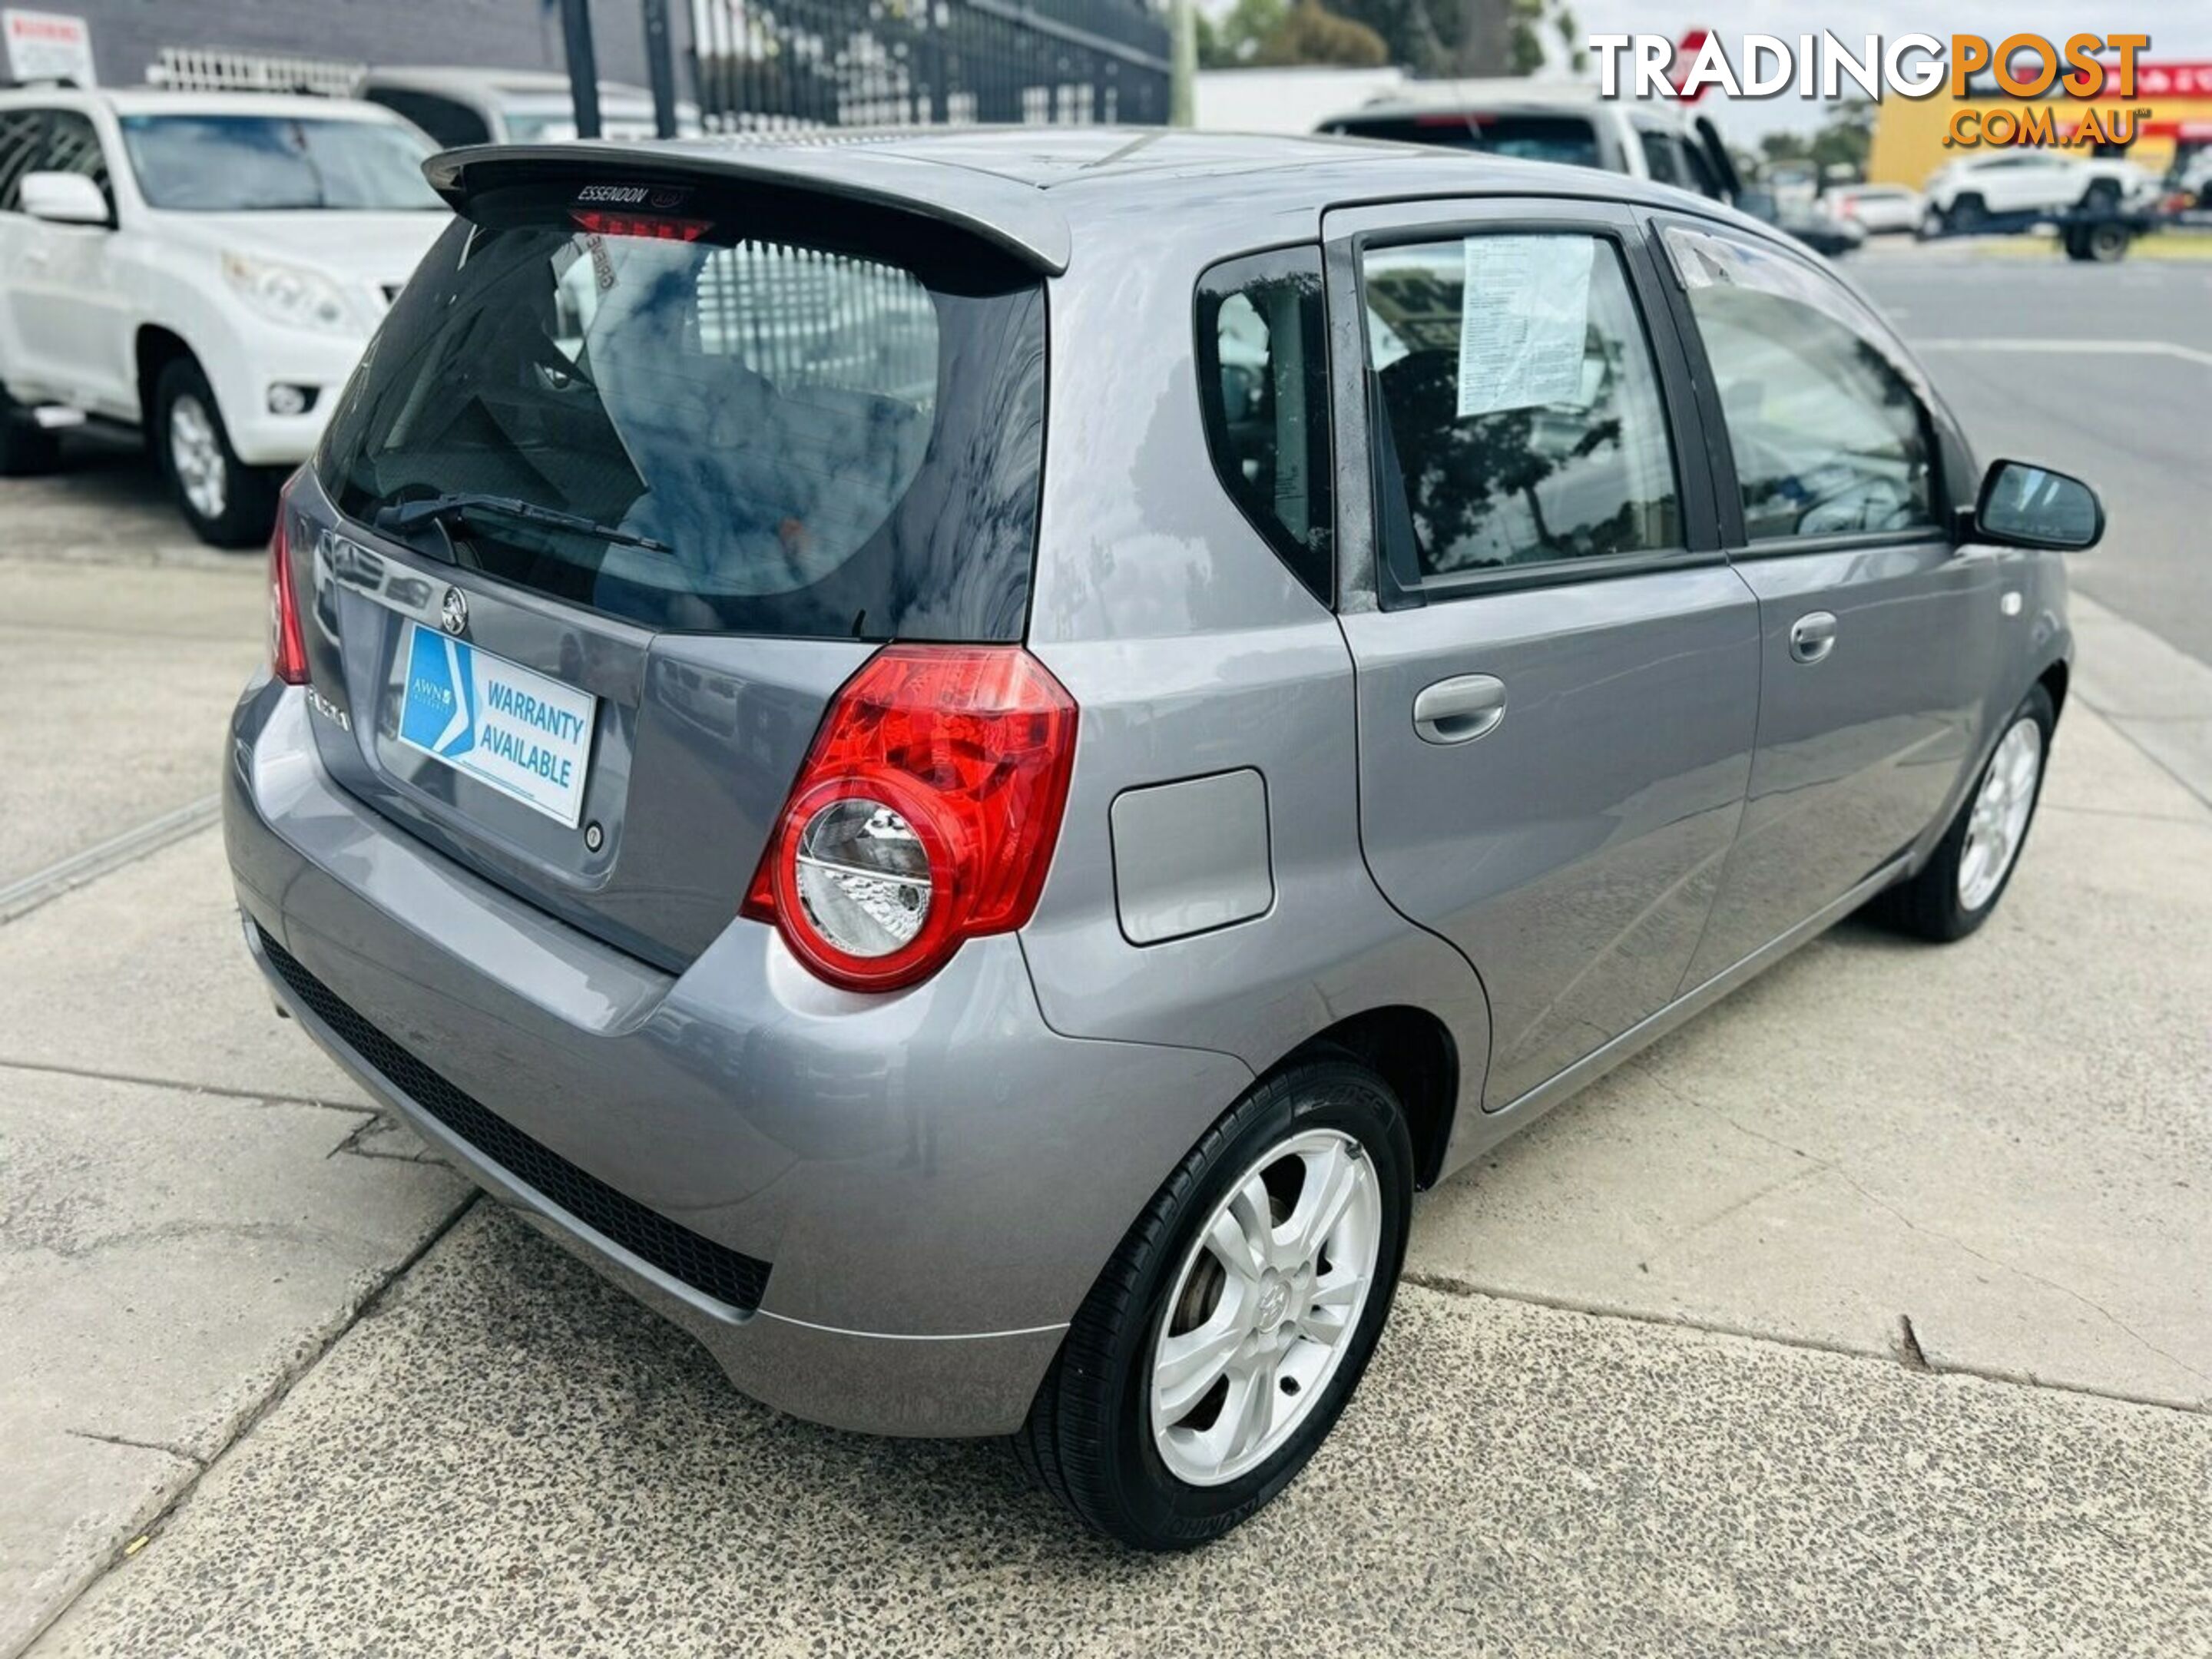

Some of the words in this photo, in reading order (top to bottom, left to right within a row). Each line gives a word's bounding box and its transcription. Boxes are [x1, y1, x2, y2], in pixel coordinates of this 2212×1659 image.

[578, 185, 649, 204] ESSENDON
[488, 680, 584, 745] WARRANTY
[480, 724, 571, 788] AVAILABLE
